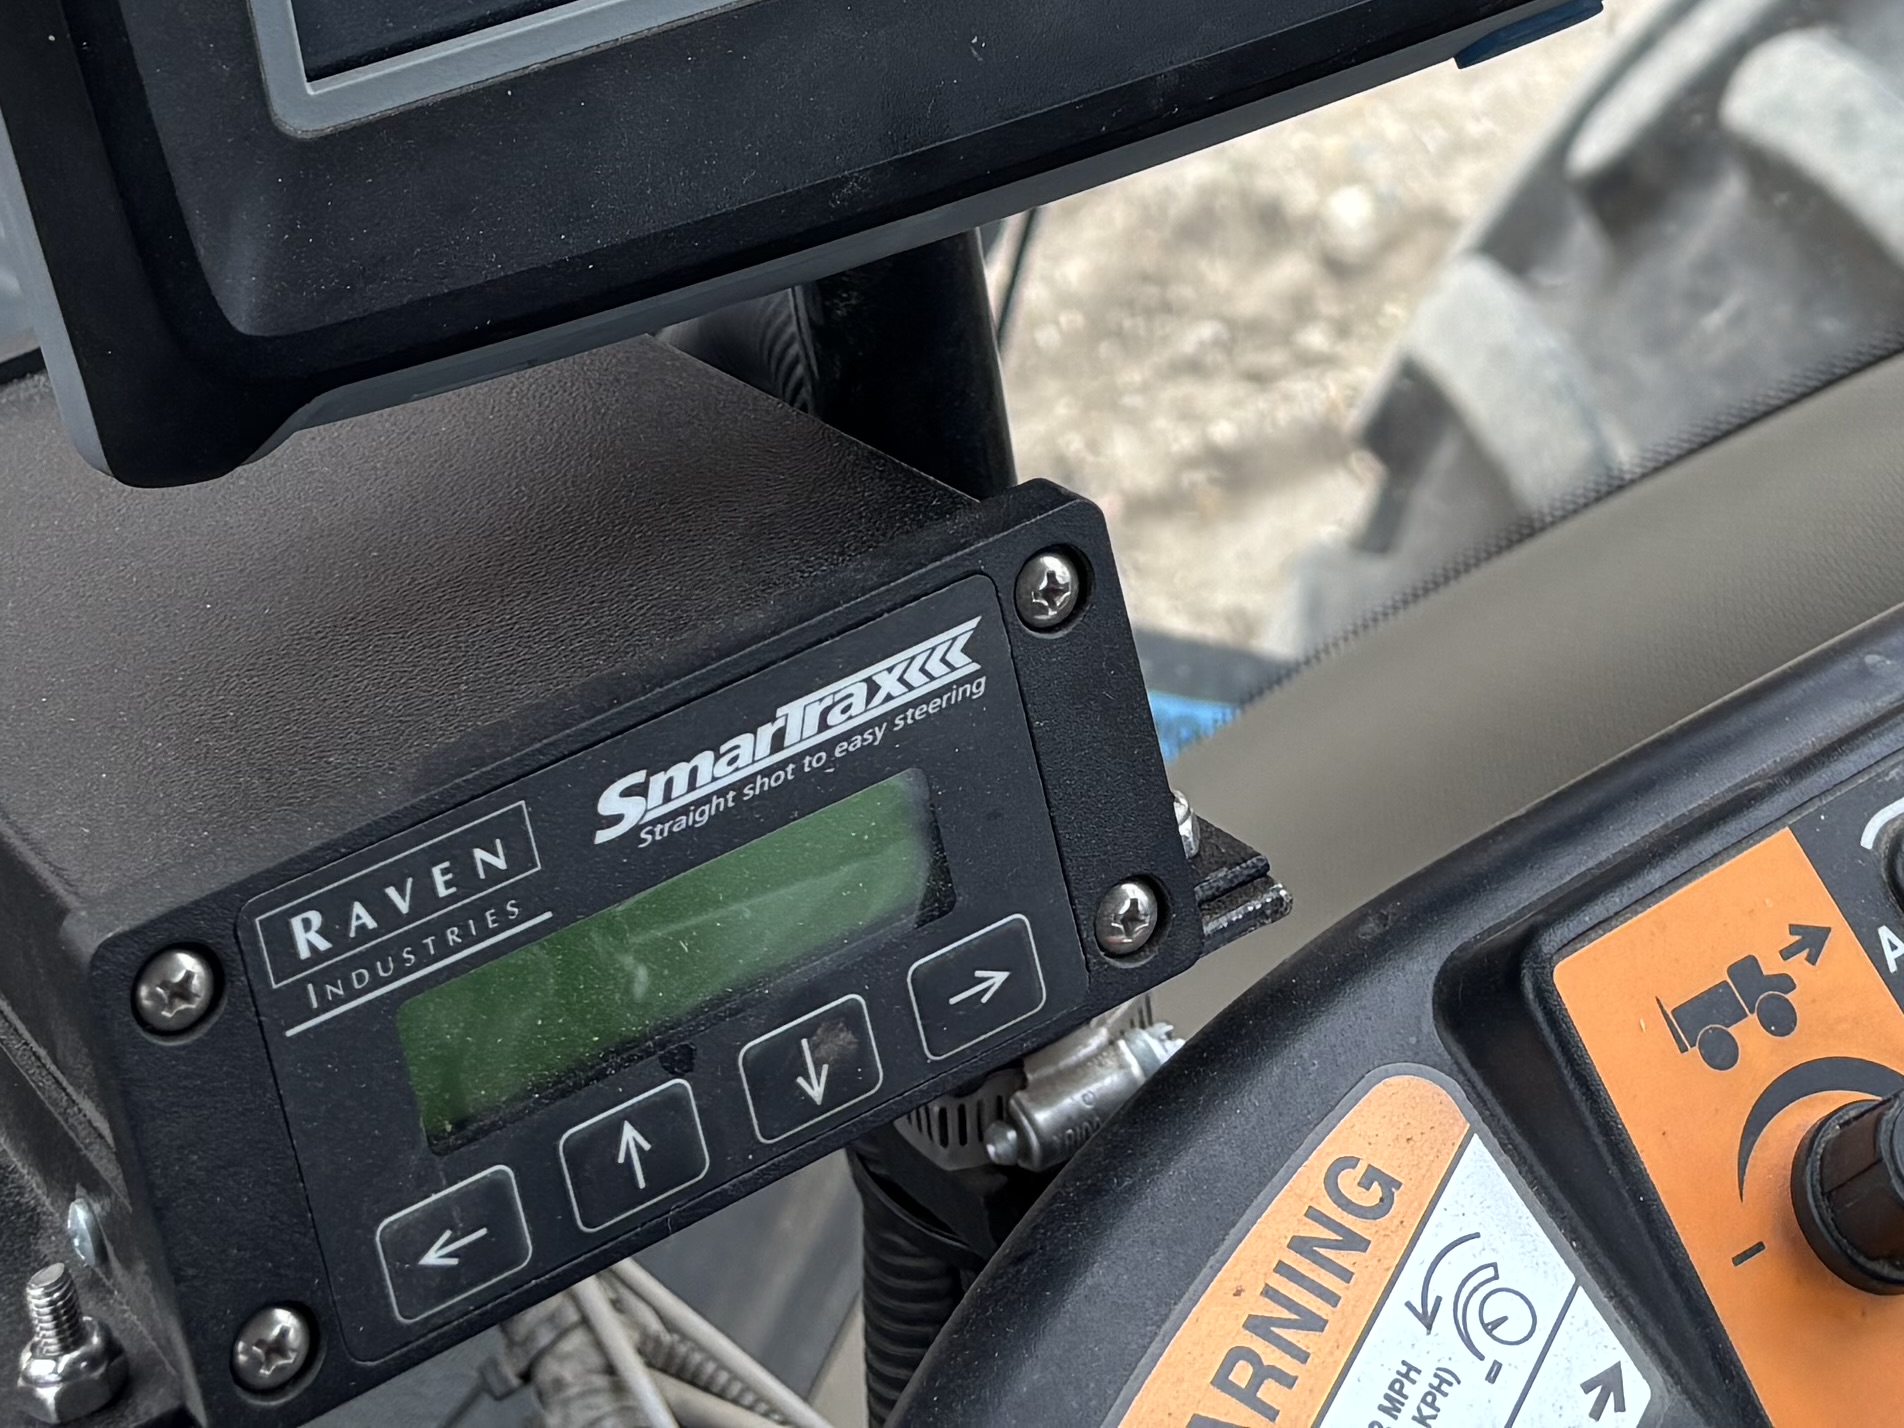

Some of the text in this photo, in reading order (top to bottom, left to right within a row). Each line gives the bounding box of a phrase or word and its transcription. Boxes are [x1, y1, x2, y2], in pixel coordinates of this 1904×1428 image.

[638, 675, 987, 847] Straight shot to easy steering
[290, 838, 507, 960] RAVEN
[308, 900, 520, 1008] INDUSTRIES
[1186, 1155, 1404, 1428] RNING
[1377, 1359, 1423, 1421] MPH
[1411, 1367, 1462, 1428] KPH)
